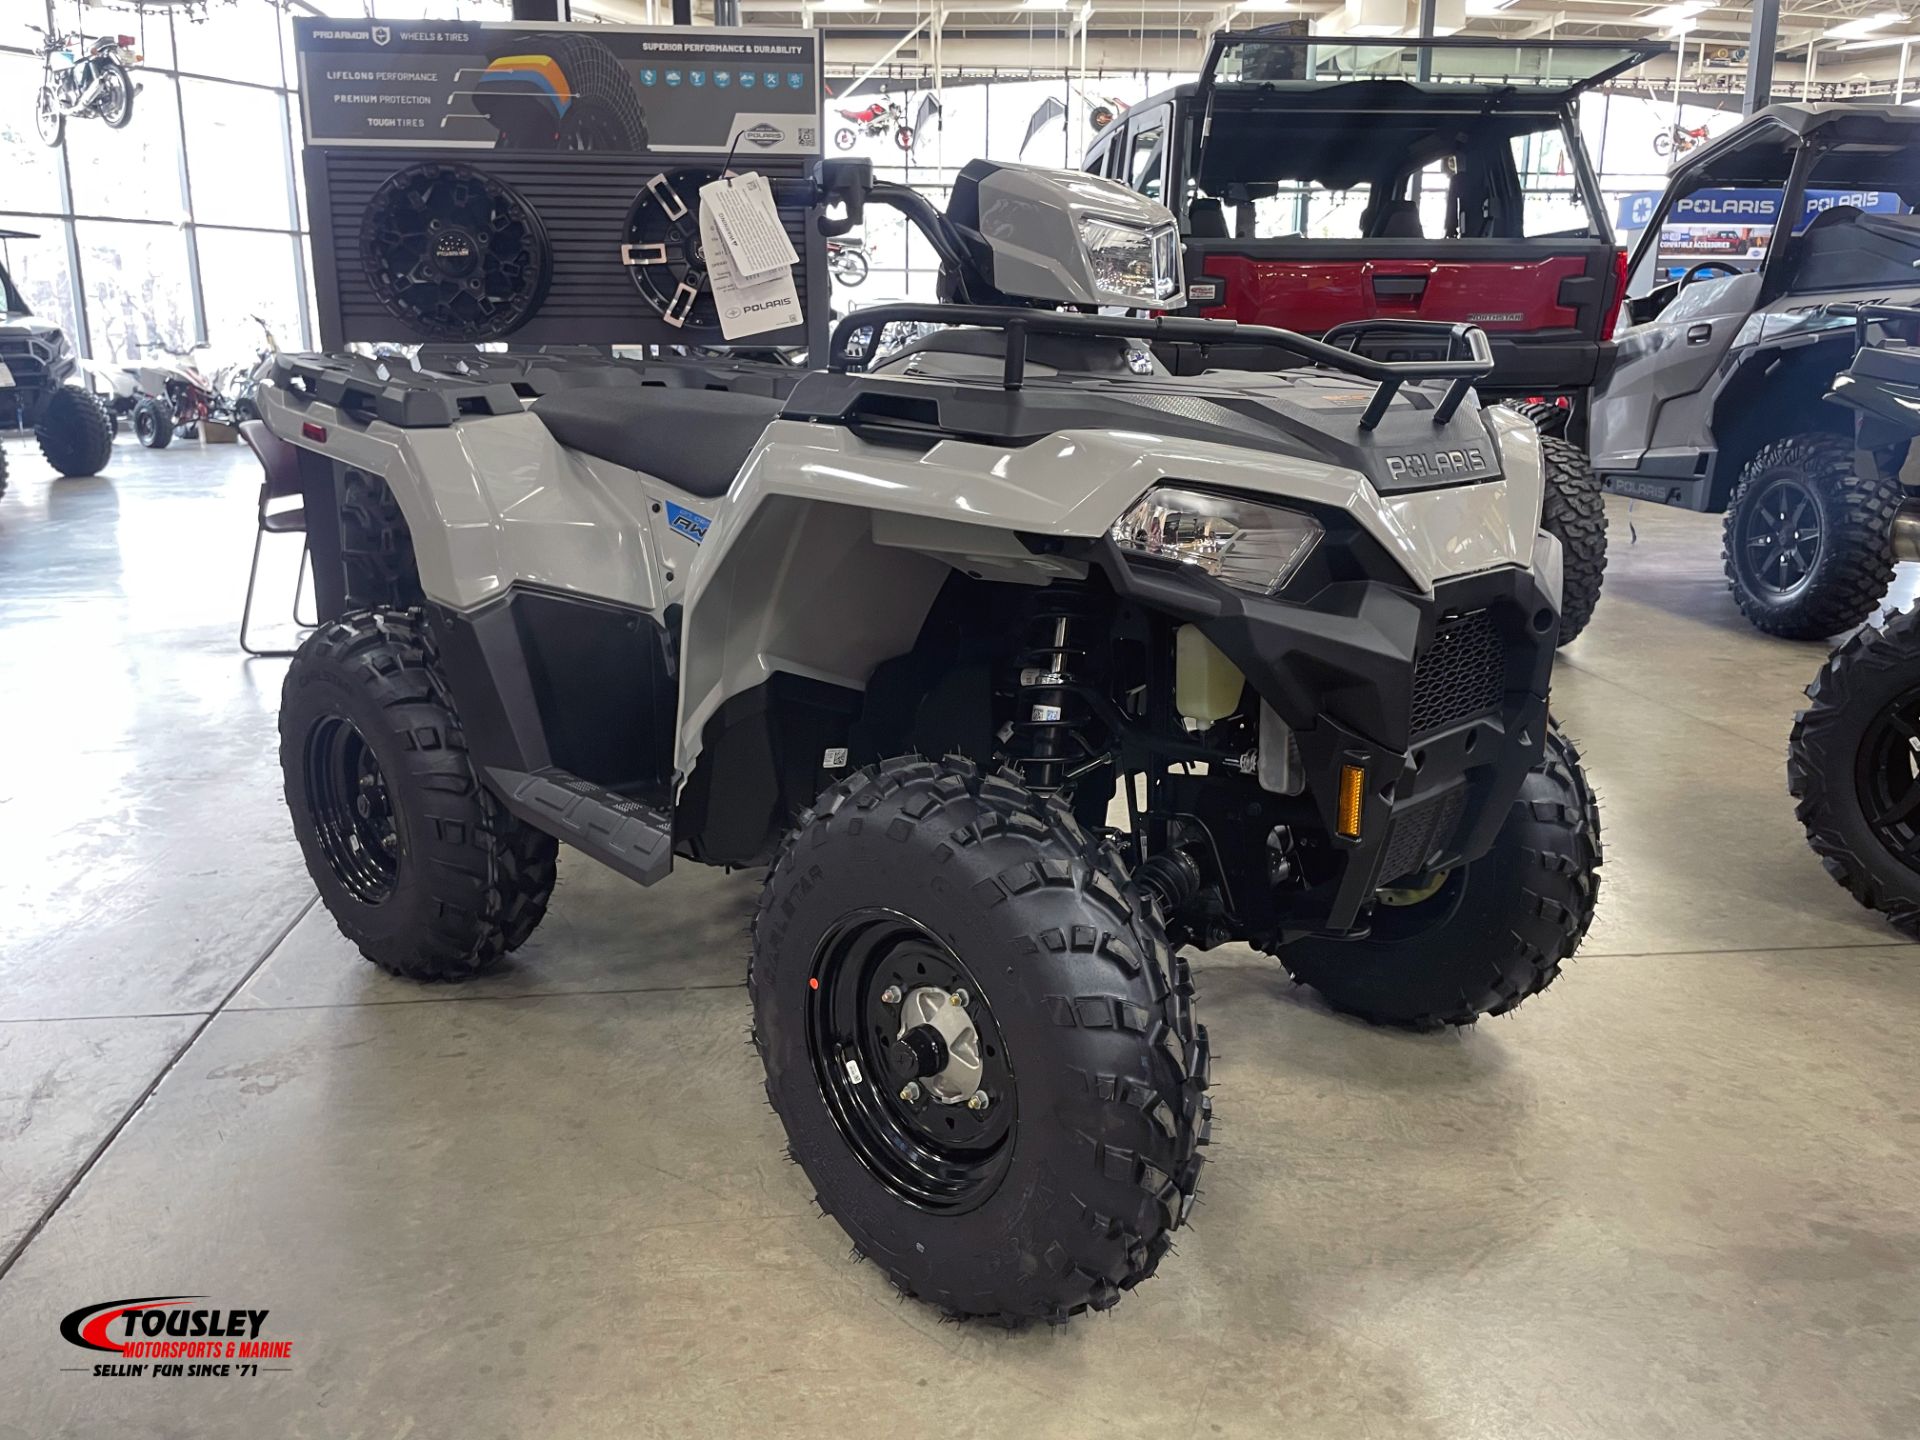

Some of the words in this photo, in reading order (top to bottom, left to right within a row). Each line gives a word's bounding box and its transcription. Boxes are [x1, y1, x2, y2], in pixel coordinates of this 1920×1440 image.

[399, 32, 436, 41] WHEELS
[436, 32, 444, 41] &
[444, 33, 470, 42] TIRES
[642, 42, 683, 52] SUPERIOR
[684, 43, 745, 53] PERFORMANCE
[746, 44, 753, 53] &
[753, 45, 802, 54] DURABILITY
[326, 71, 375, 80] LIFELONG
[375, 72, 439, 82] PERFORMANCE
[333, 94, 378, 104] PREMIUM
[379, 95, 431, 105] PROTECTION
[367, 117, 396, 127] TOUGH
[396, 118, 425, 128] TIRES
[1677, 199, 1775, 214] POLARIS
[743, 297, 792, 314] POLARIS
[1385, 448, 1486, 480] POLARIS
[1616, 480, 1665, 497] POLARIS
[672, 515, 708, 538] AW
